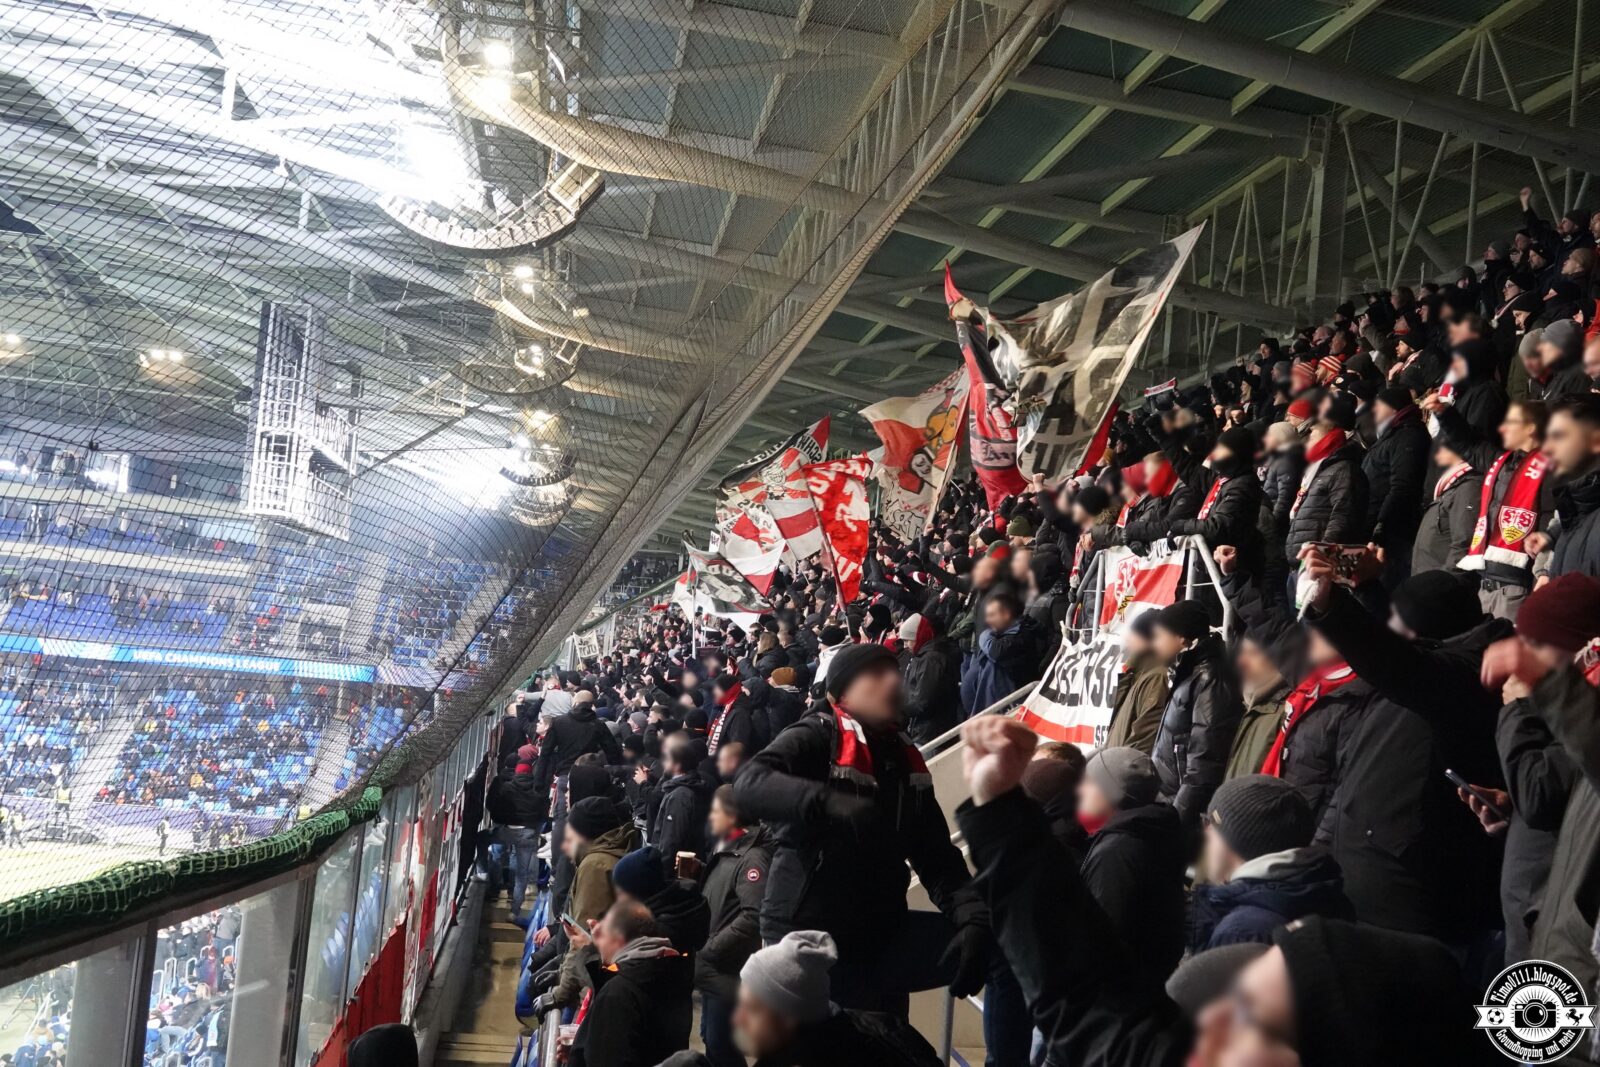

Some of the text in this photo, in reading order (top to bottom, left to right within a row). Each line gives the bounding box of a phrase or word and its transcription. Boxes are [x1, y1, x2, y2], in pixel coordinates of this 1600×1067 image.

[133, 650, 280, 671] UEFA CHAMPIONS LEAGUE
